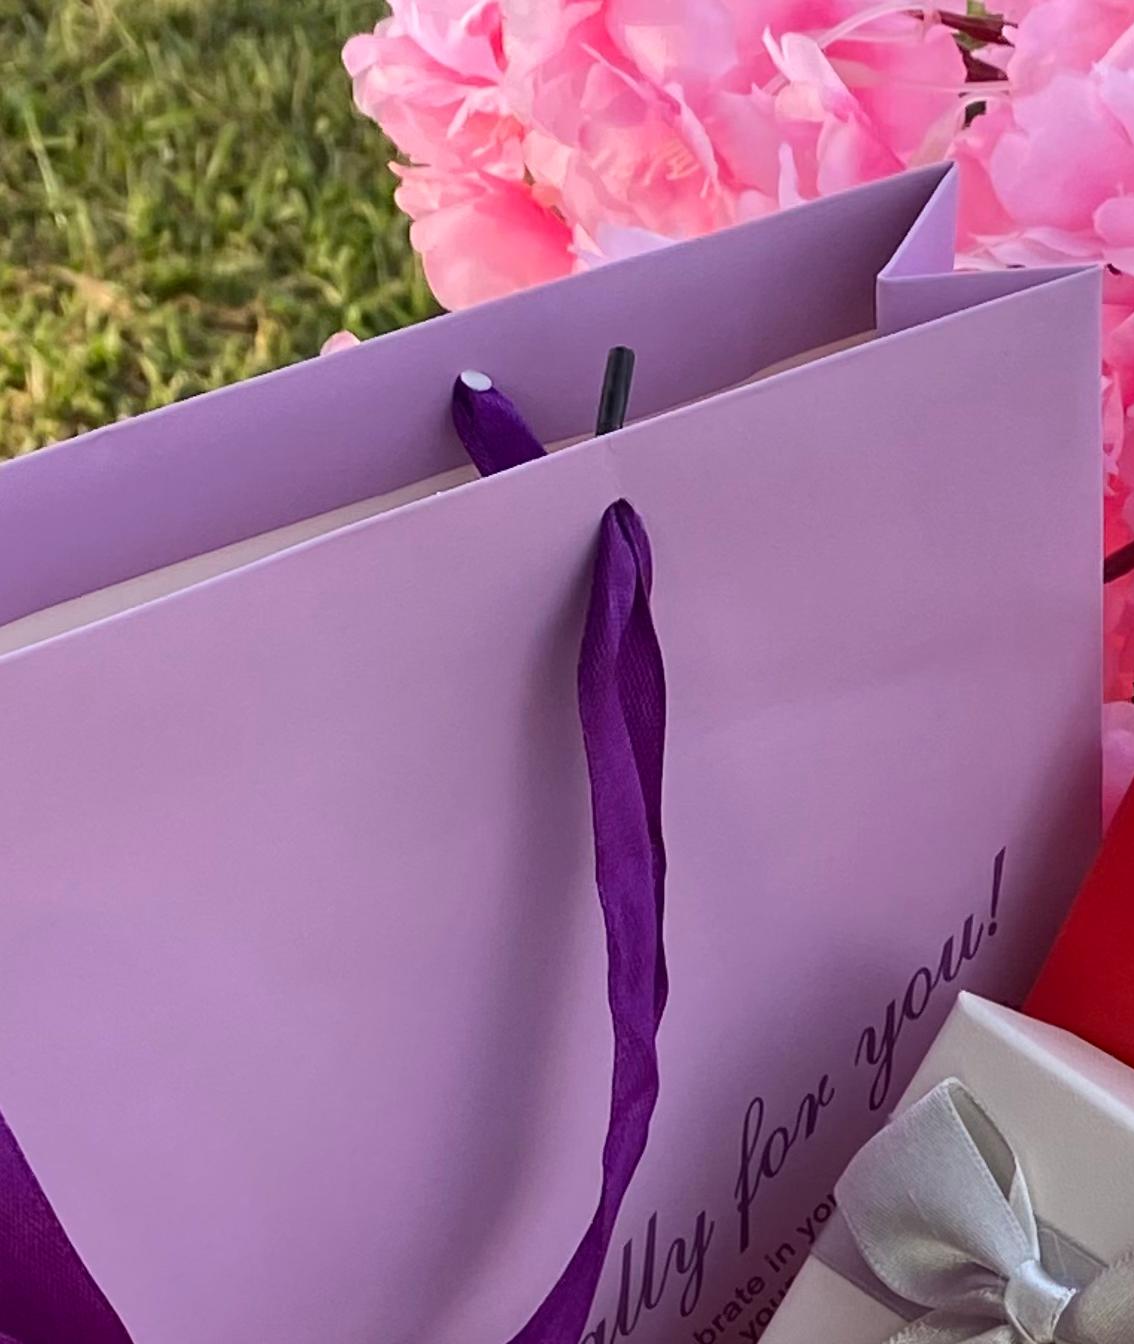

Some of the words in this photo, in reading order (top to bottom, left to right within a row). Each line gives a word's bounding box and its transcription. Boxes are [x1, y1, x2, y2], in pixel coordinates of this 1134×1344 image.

[734, 1074, 835, 1253] for
[855, 846, 1006, 1111] you!
[764, 1242, 795, 1273] in
